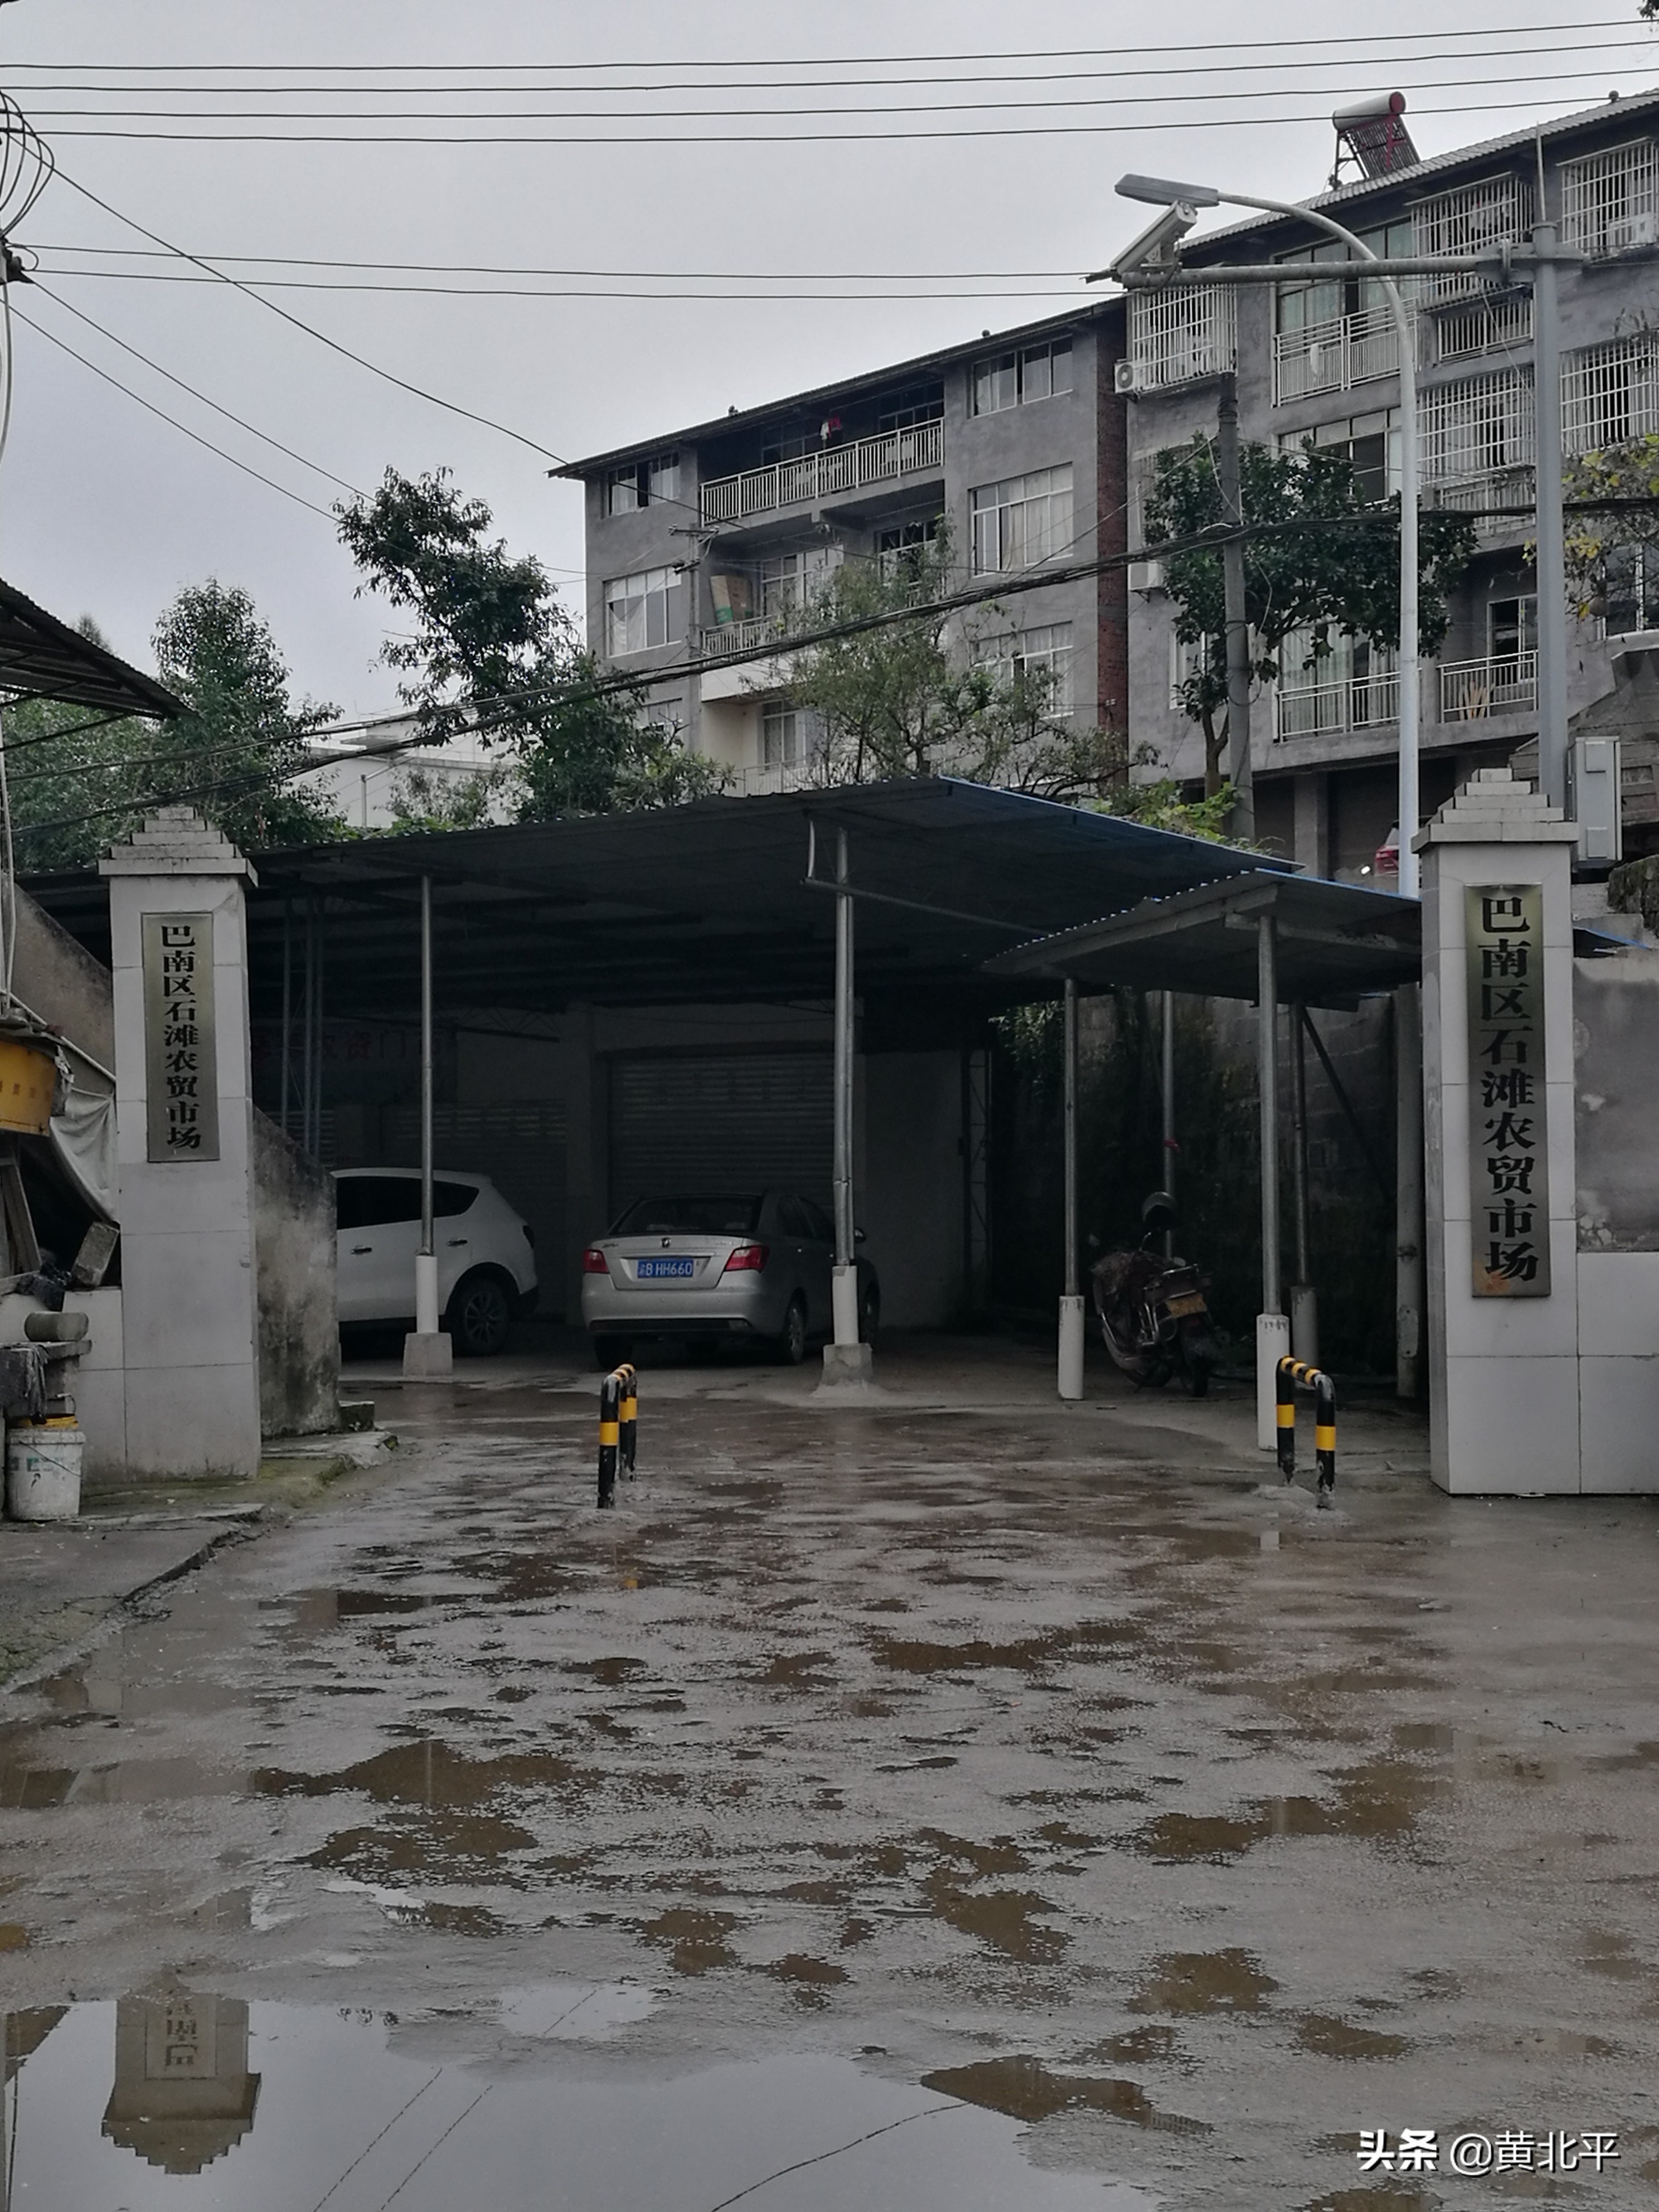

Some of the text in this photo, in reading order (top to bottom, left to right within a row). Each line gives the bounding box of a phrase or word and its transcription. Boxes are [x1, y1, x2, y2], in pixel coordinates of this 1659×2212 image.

[161, 925, 202, 1150] 巴南区石滩农贸市场
[1478, 896, 1540, 1282] 巴南区石滩农贸市场
